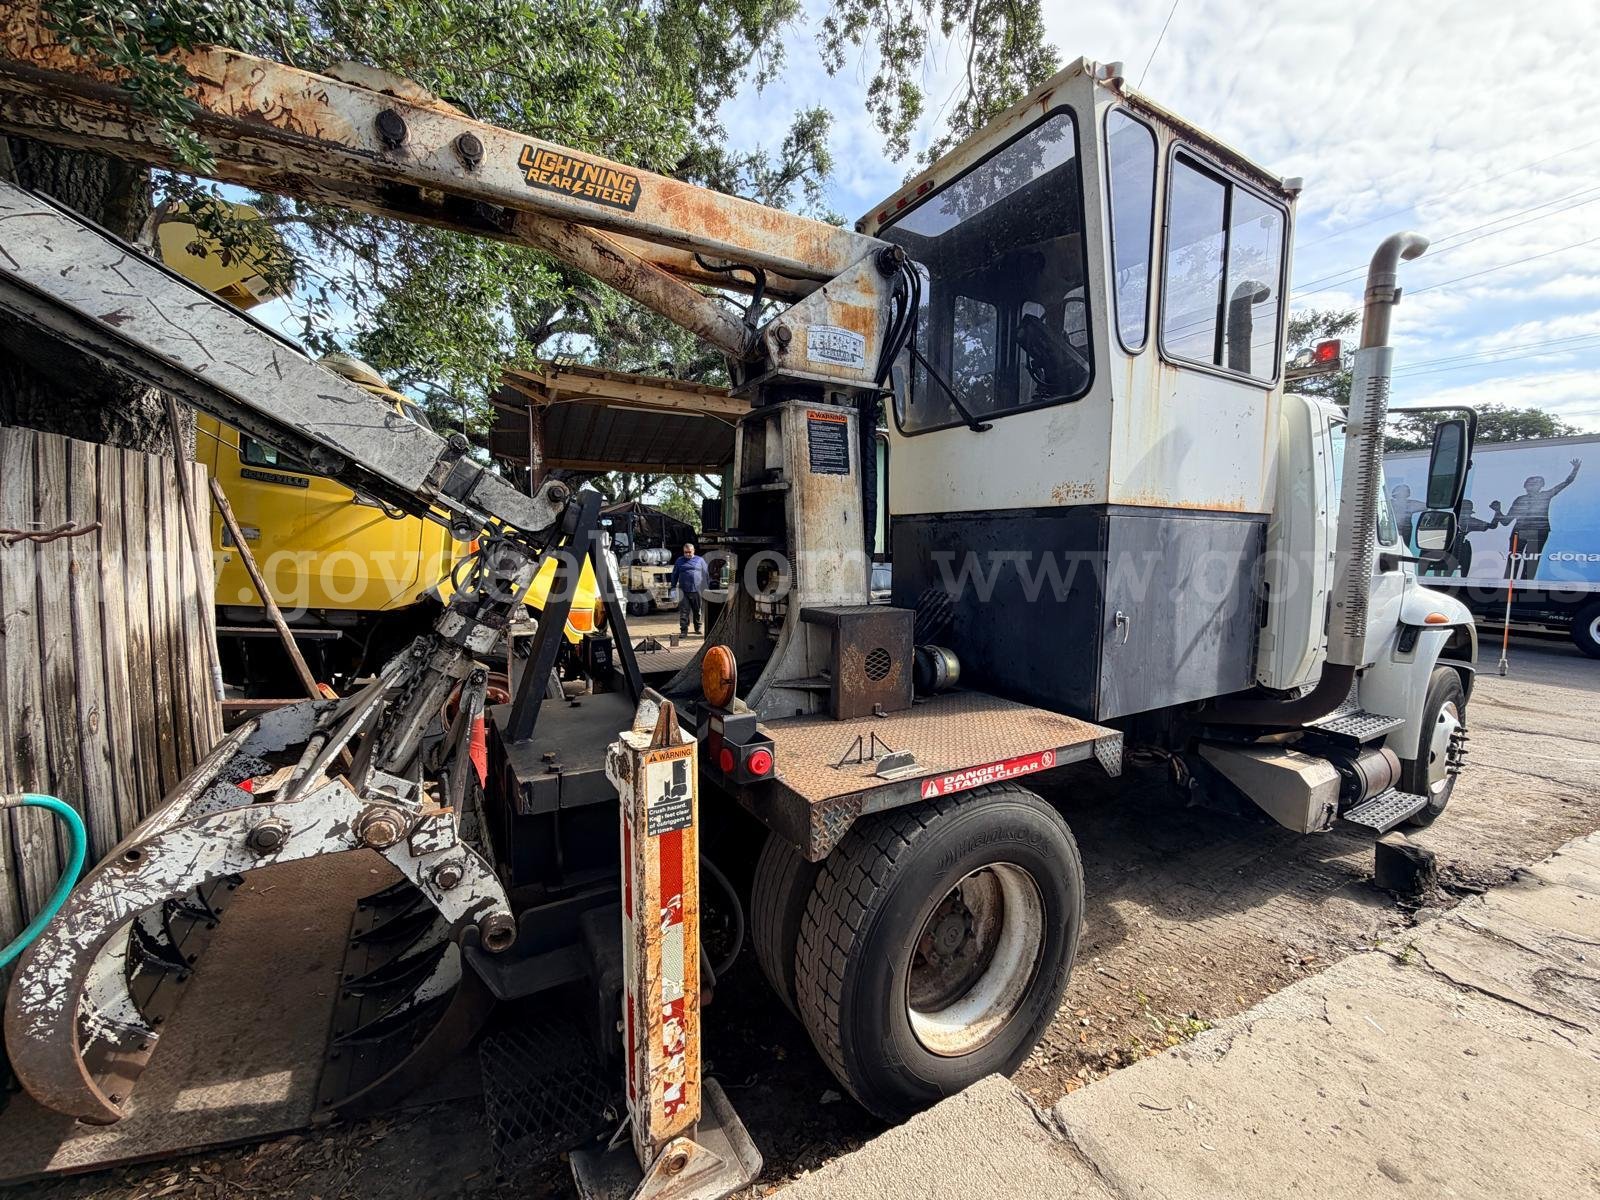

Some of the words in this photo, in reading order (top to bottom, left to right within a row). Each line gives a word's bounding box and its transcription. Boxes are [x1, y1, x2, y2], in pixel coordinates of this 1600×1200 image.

[519, 145, 638, 193] LIGHTNING
[527, 168, 571, 190] REAR
[584, 183, 633, 206] STEER
[659, 749, 691, 761] WARNING
[943, 763, 1004, 785] DANGER
[943, 774, 995, 793] STAND
[996, 762, 1039, 779] CLEAR
[649, 807, 667, 816] Crush
[657, 817, 685, 827] outriggers
